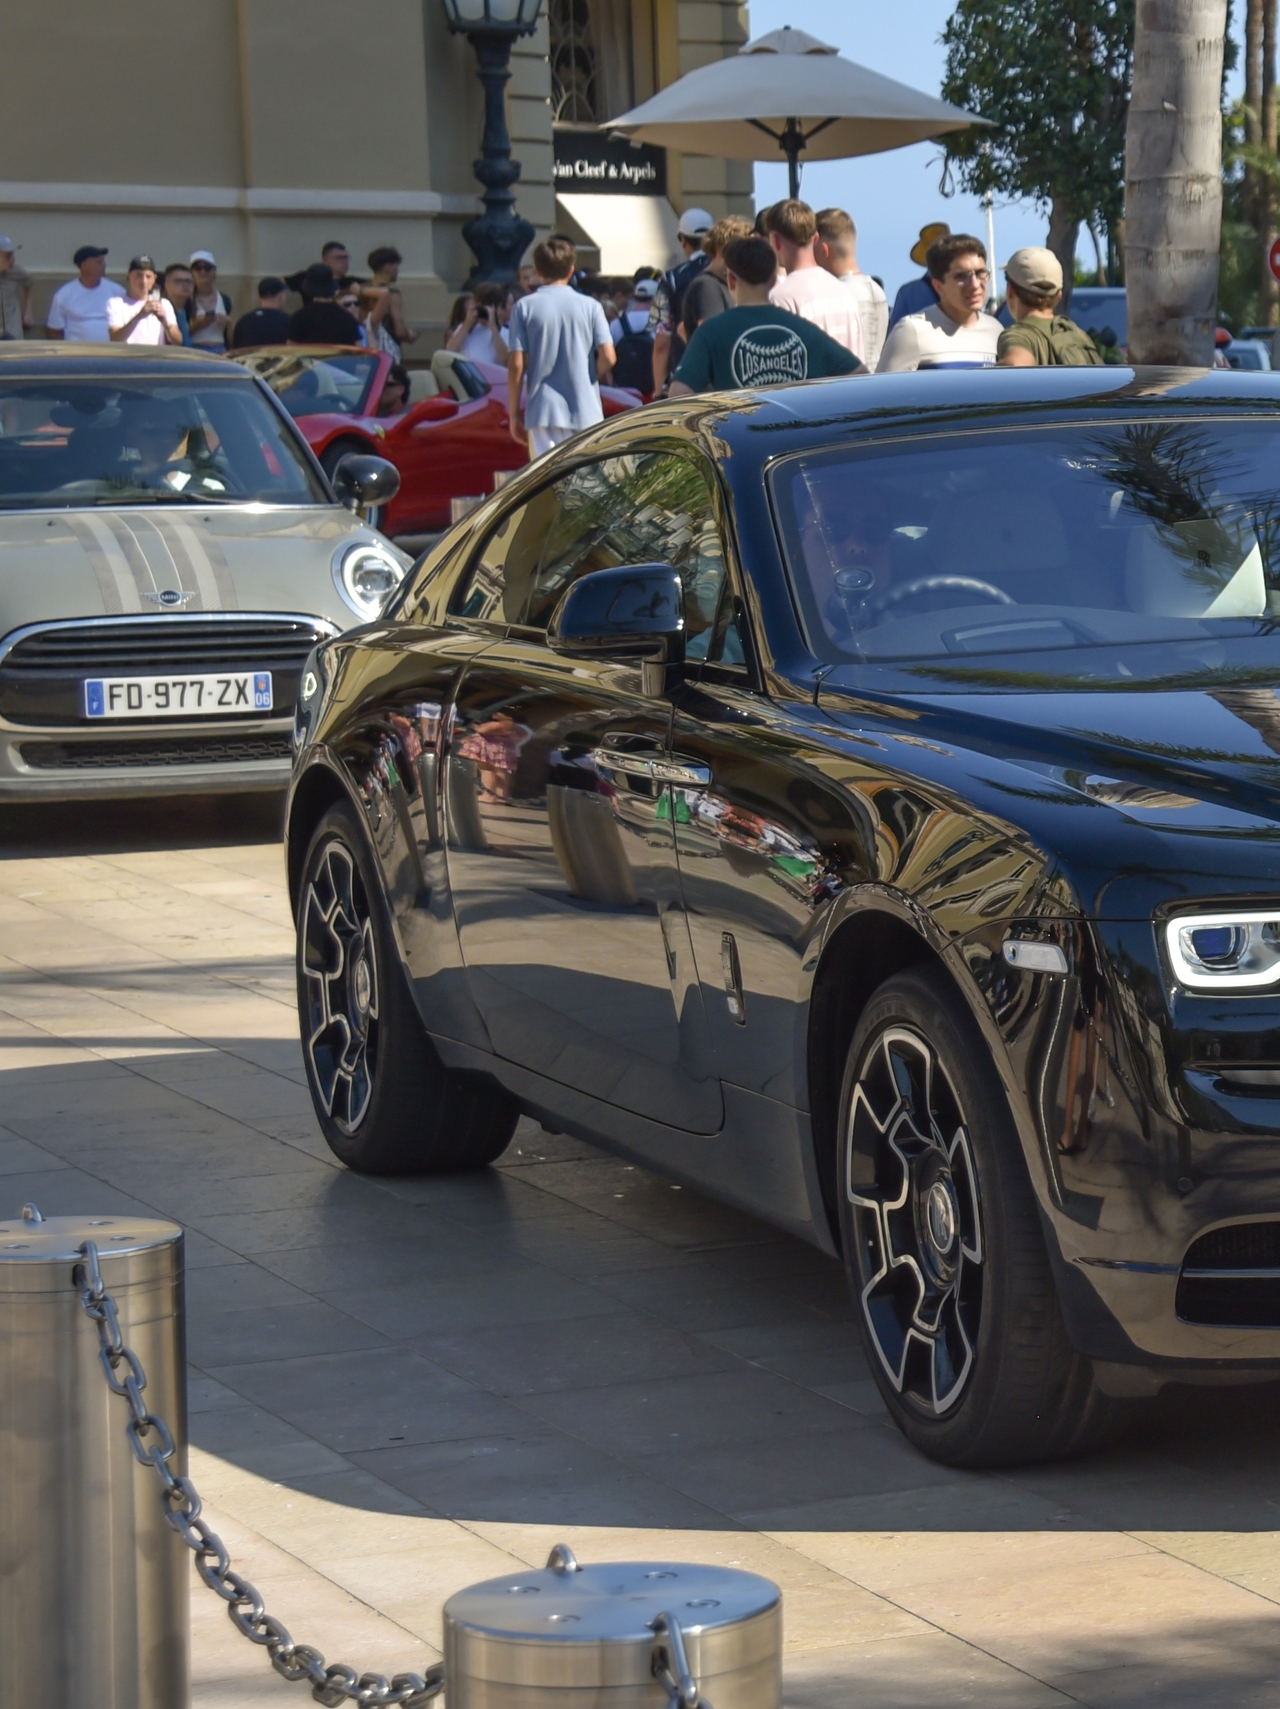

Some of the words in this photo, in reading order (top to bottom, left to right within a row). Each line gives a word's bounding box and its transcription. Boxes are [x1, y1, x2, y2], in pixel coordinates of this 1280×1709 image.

[575, 159, 607, 178] Cleef
[608, 163, 618, 179] &
[619, 161, 656, 185] Arpels
[108, 678, 249, 711] FD-977-ZX
[254, 691, 270, 706] 06
[92, 701, 99, 711] F
